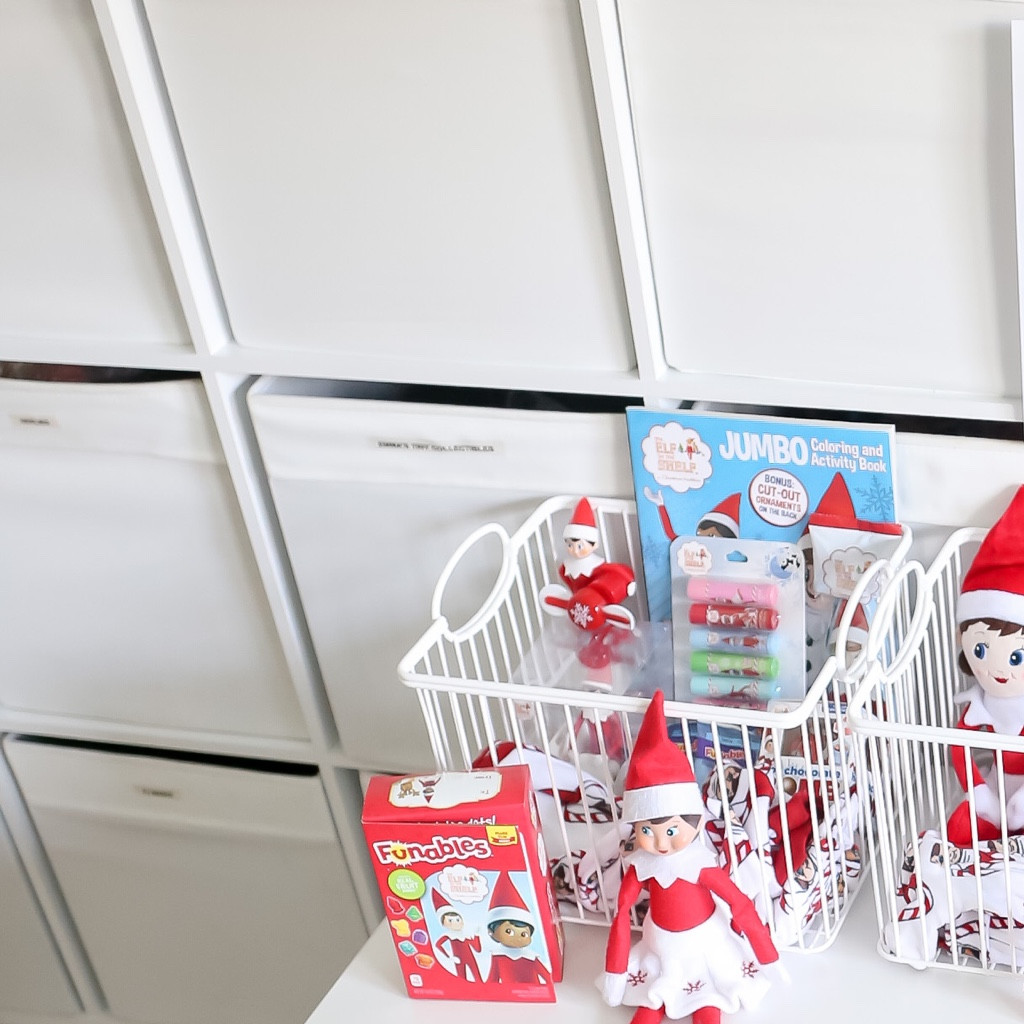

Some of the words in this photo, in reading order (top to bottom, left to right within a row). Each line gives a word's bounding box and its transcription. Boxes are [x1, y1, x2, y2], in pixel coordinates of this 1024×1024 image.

[718, 430, 809, 466] JUMBO
[810, 438, 859, 456] Coloring
[861, 442, 883, 457] and
[810, 452, 857, 473] Activity
[859, 458, 887, 472] Book
[764, 473, 795, 490] BONUS:
[757, 484, 801, 502] CUT-OUT
[755, 495, 801, 513] ORNAMENTS
[759, 506, 768, 514] ON
[769, 507, 780, 516] THE
[781, 510, 797, 520] BACK
[373, 837, 491, 865] Funables
